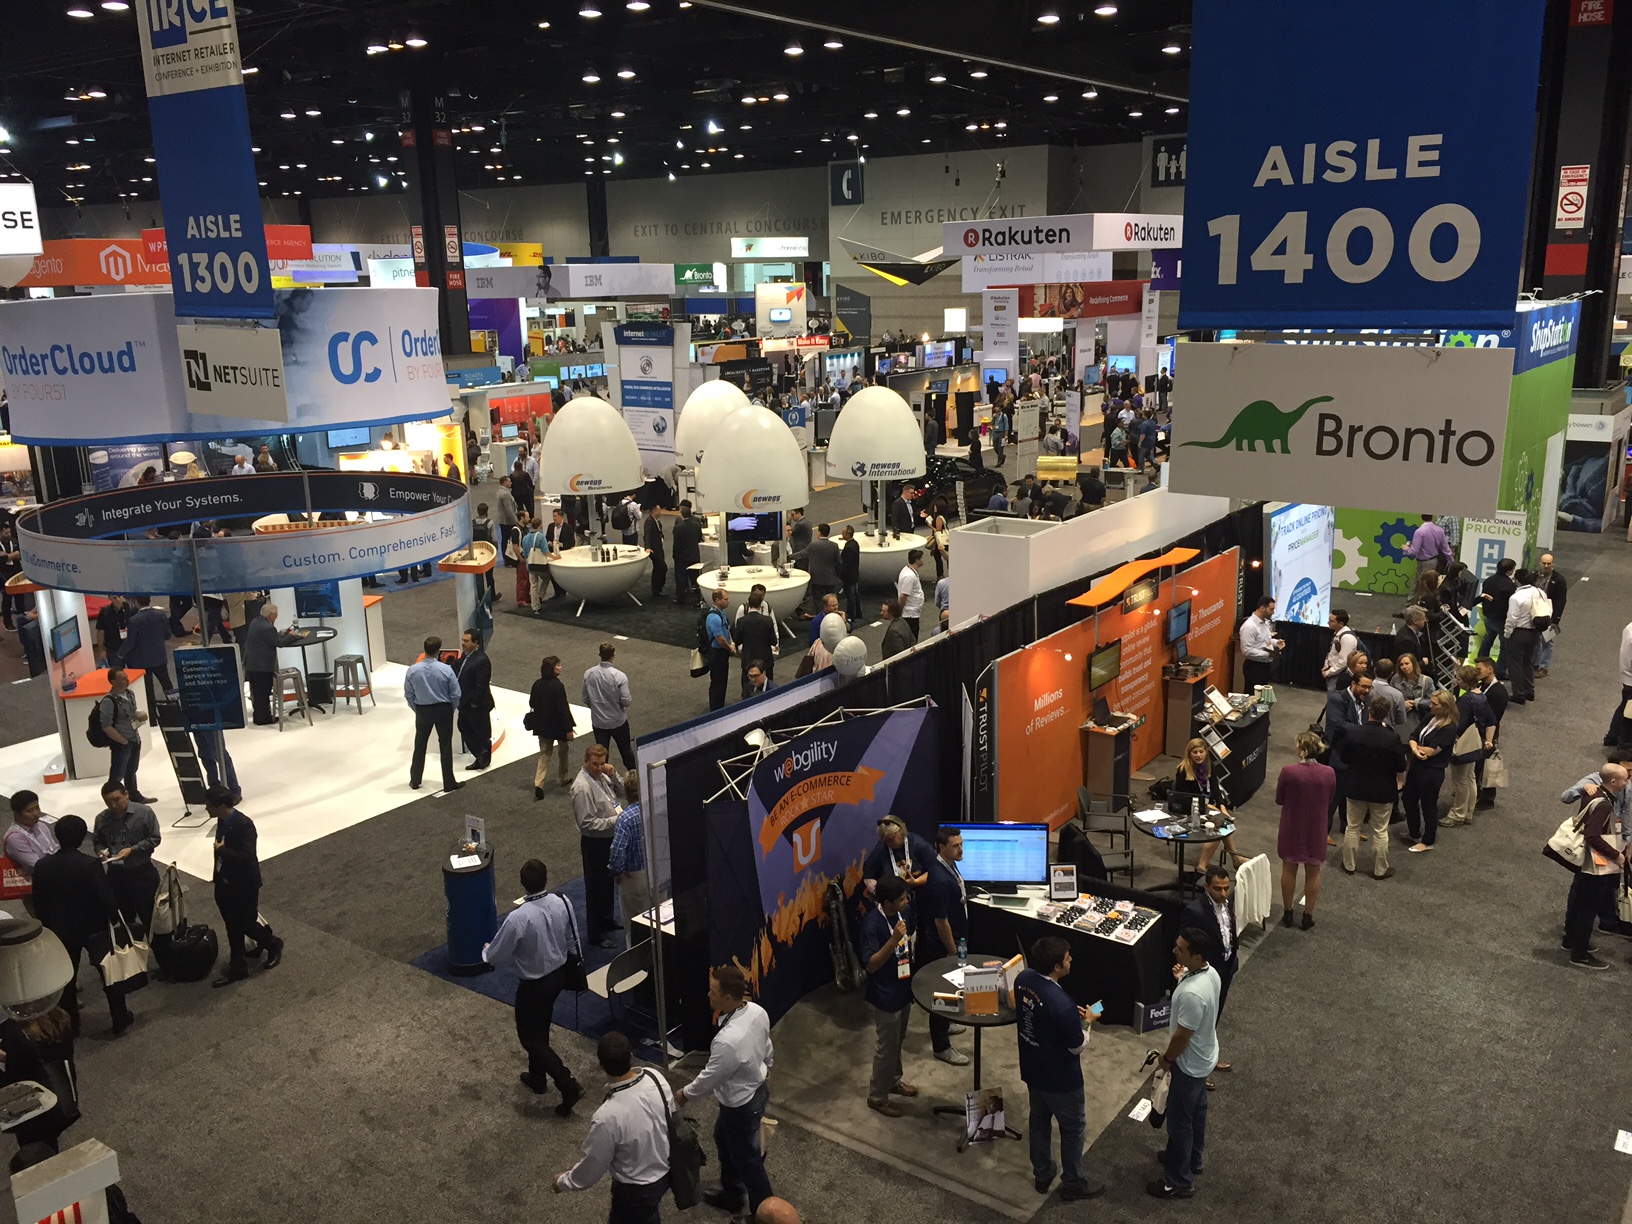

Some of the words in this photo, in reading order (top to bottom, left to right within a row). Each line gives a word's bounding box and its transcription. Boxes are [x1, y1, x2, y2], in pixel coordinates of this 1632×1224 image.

[1582, 0, 1604, 11] FIRE
[1578, 11, 1605, 22] HOSE
[153, 50, 191, 67] INTERNET
[194, 42, 236, 59] RETAILER
[155, 67, 194, 81] CONFERENCE
[201, 60, 238, 74] EXHIBITION
[434, 111, 446, 123] 32
[1253, 133, 1443, 188] AISLE
[2, 211, 34, 229] SE
[881, 207, 979, 226] EMERGENCY
[988, 204, 1026, 220] EXIT
[187, 214, 243, 239] AISLE
[464, 229, 524, 242] CONCOURSE
[634, 225, 658, 238] EXIT
[665, 223, 679, 236] TO
[684, 220, 741, 236] CENTRAL
[745, 216, 828, 234] CONCOURSE
[982, 226, 1071, 247] Rakuten
[1134, 222, 1176, 242] Rakuten
[1206, 203, 1481, 285] 1400
[314, 254, 342, 262] LUTION
[860, 253, 886, 261] KIBO
[29, 257, 63, 279] agento
[177, 251, 260, 294] 1300
[694, 272, 713, 281] Bronto
[1014, 264, 1034, 273] Retail
[476, 277, 494, 289] IBM
[584, 274, 602, 287] IBM
[1530, 315, 1575, 358] ShipStation
[2, 341, 136, 376] OrderCloud
[213, 364, 281, 388] NETSUITE
[1572, 421, 1593, 429] bowes
[1315, 412, 1495, 467] Bronto
[867, 467, 917, 477] International
[870, 461, 901, 471] newegg
[576, 479, 603, 487] newegg
[389, 488, 431, 502] Empower
[432, 492, 447, 503] Your
[752, 495, 781, 504] newegg
[102, 503, 152, 521] Integrate
[154, 500, 182, 512] Your
[186, 493, 243, 509] Systems.
[1281, 523, 1296, 537] TRACK
[1295, 513, 1311, 530] ONLINE
[1465, 523, 1522, 537] PRICING
[1494, 518, 1523, 527] ONLINE
[283, 552, 345, 569] Custom.
[348, 532, 440, 561] Comprehensive.
[440, 525, 457, 539] Fast.
[1034, 688, 1063, 712] Millions
[1025, 719, 1034, 736] of
[978, 702, 988, 793] TRUSTPILOT
[774, 740, 839, 783] webgility
[769, 811, 779, 827] BE
[779, 797, 790, 812] AN
[790, 774, 853, 803] E-COMMERCE
[780, 805, 800, 827] ROCK
[810, 789, 835, 806] STAR
[1150, 1006, 1172, 1019] FedE
